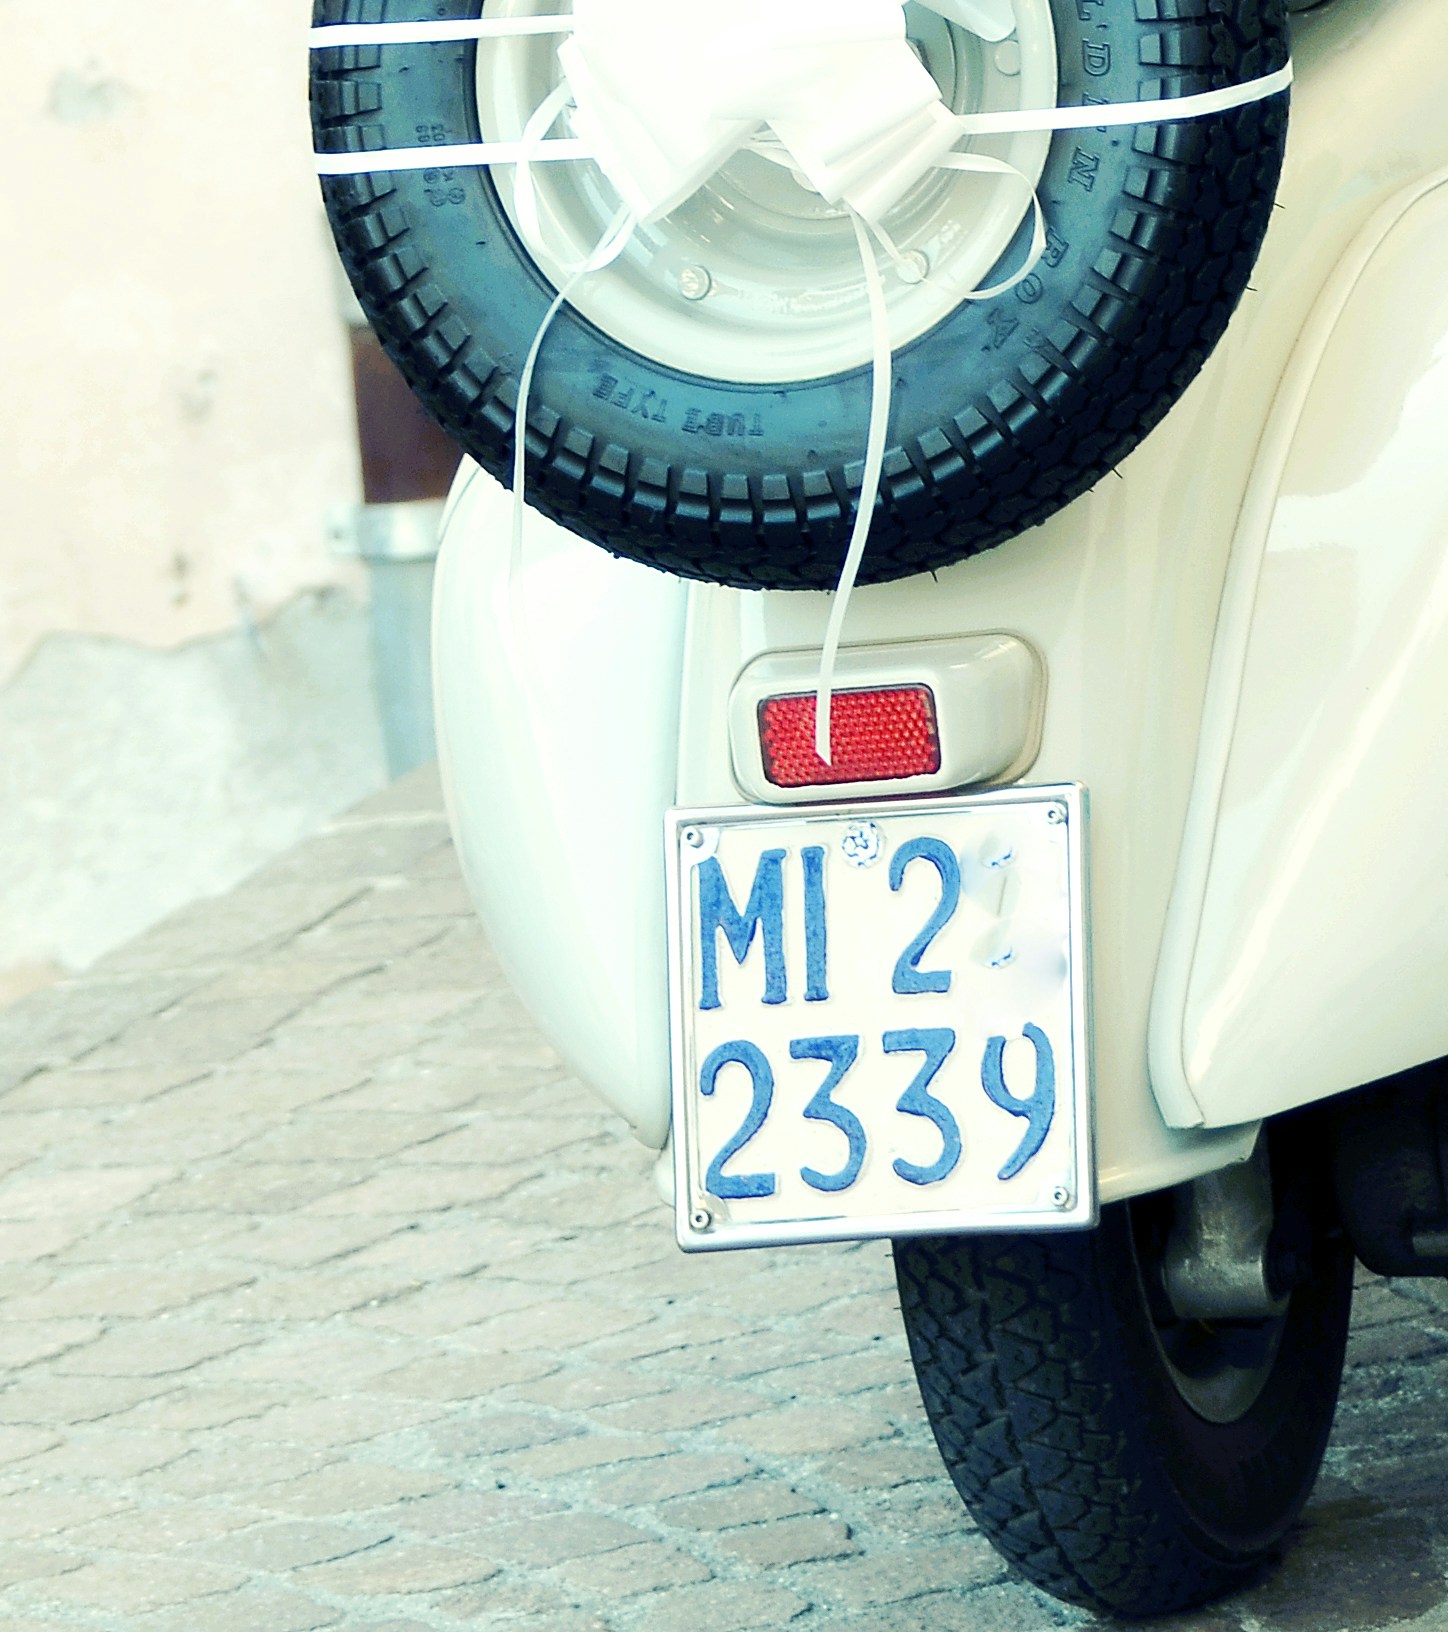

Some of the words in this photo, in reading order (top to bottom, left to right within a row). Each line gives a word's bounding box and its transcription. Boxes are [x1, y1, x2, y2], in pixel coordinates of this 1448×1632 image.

[699, 845, 829, 1010] MI
[889, 836, 962, 994] 2
[699, 1020, 1057, 1200] 2339
